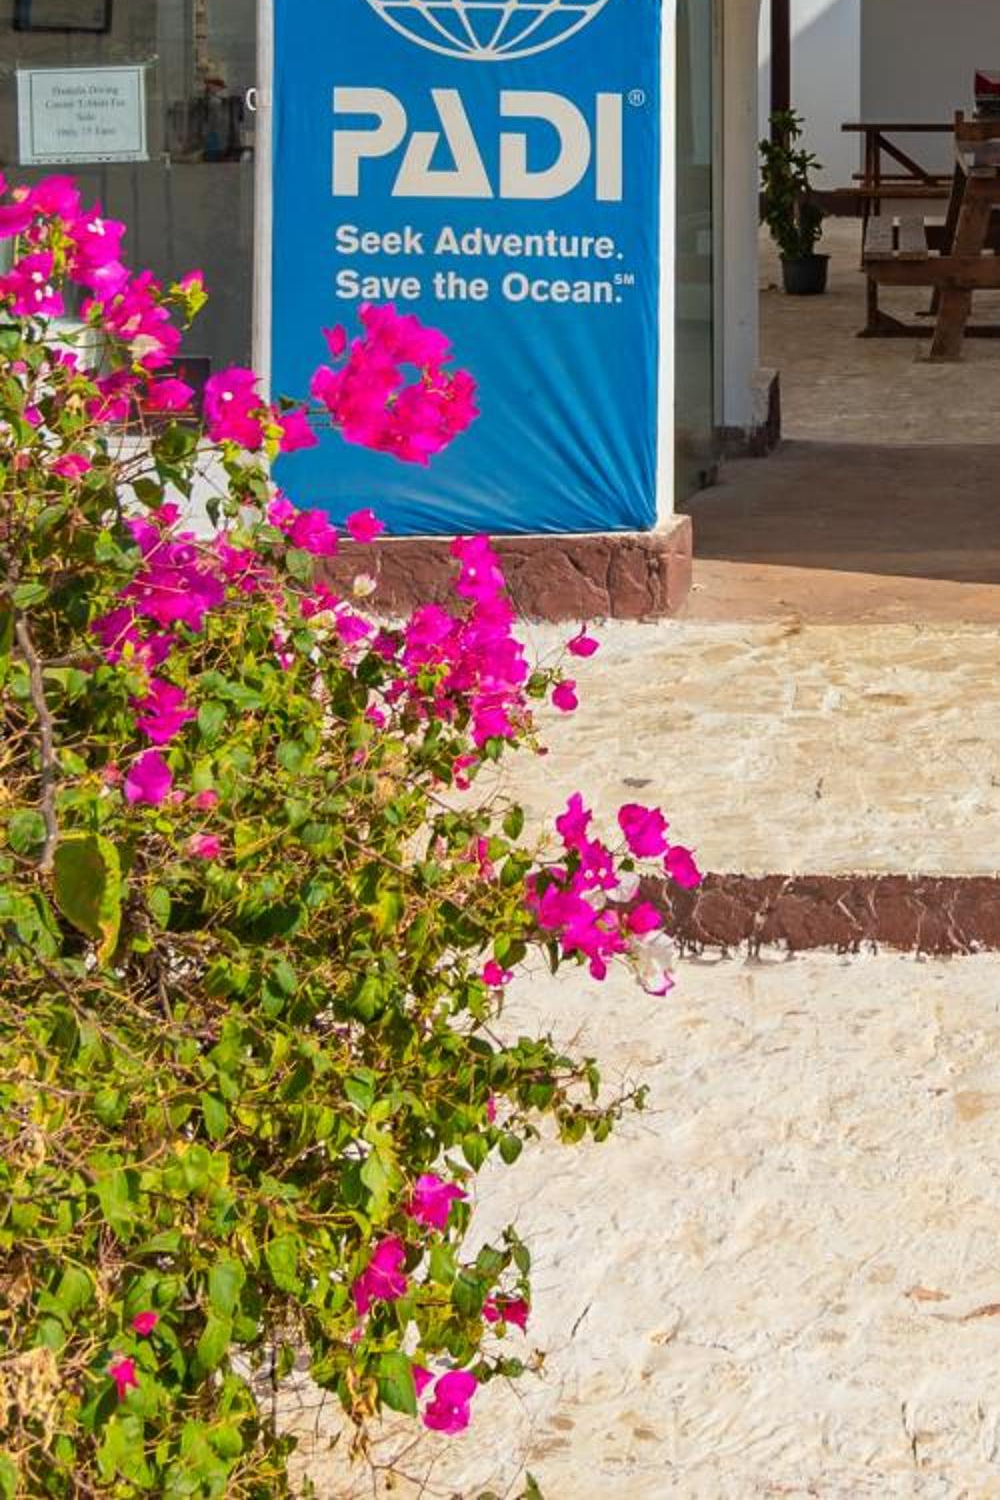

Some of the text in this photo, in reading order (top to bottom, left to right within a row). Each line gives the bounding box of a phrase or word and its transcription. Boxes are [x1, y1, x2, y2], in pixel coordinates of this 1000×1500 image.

[335, 225, 624, 260] Seek Adventure.
[335, 269, 421, 300] Save
[433, 272, 489, 301] the
